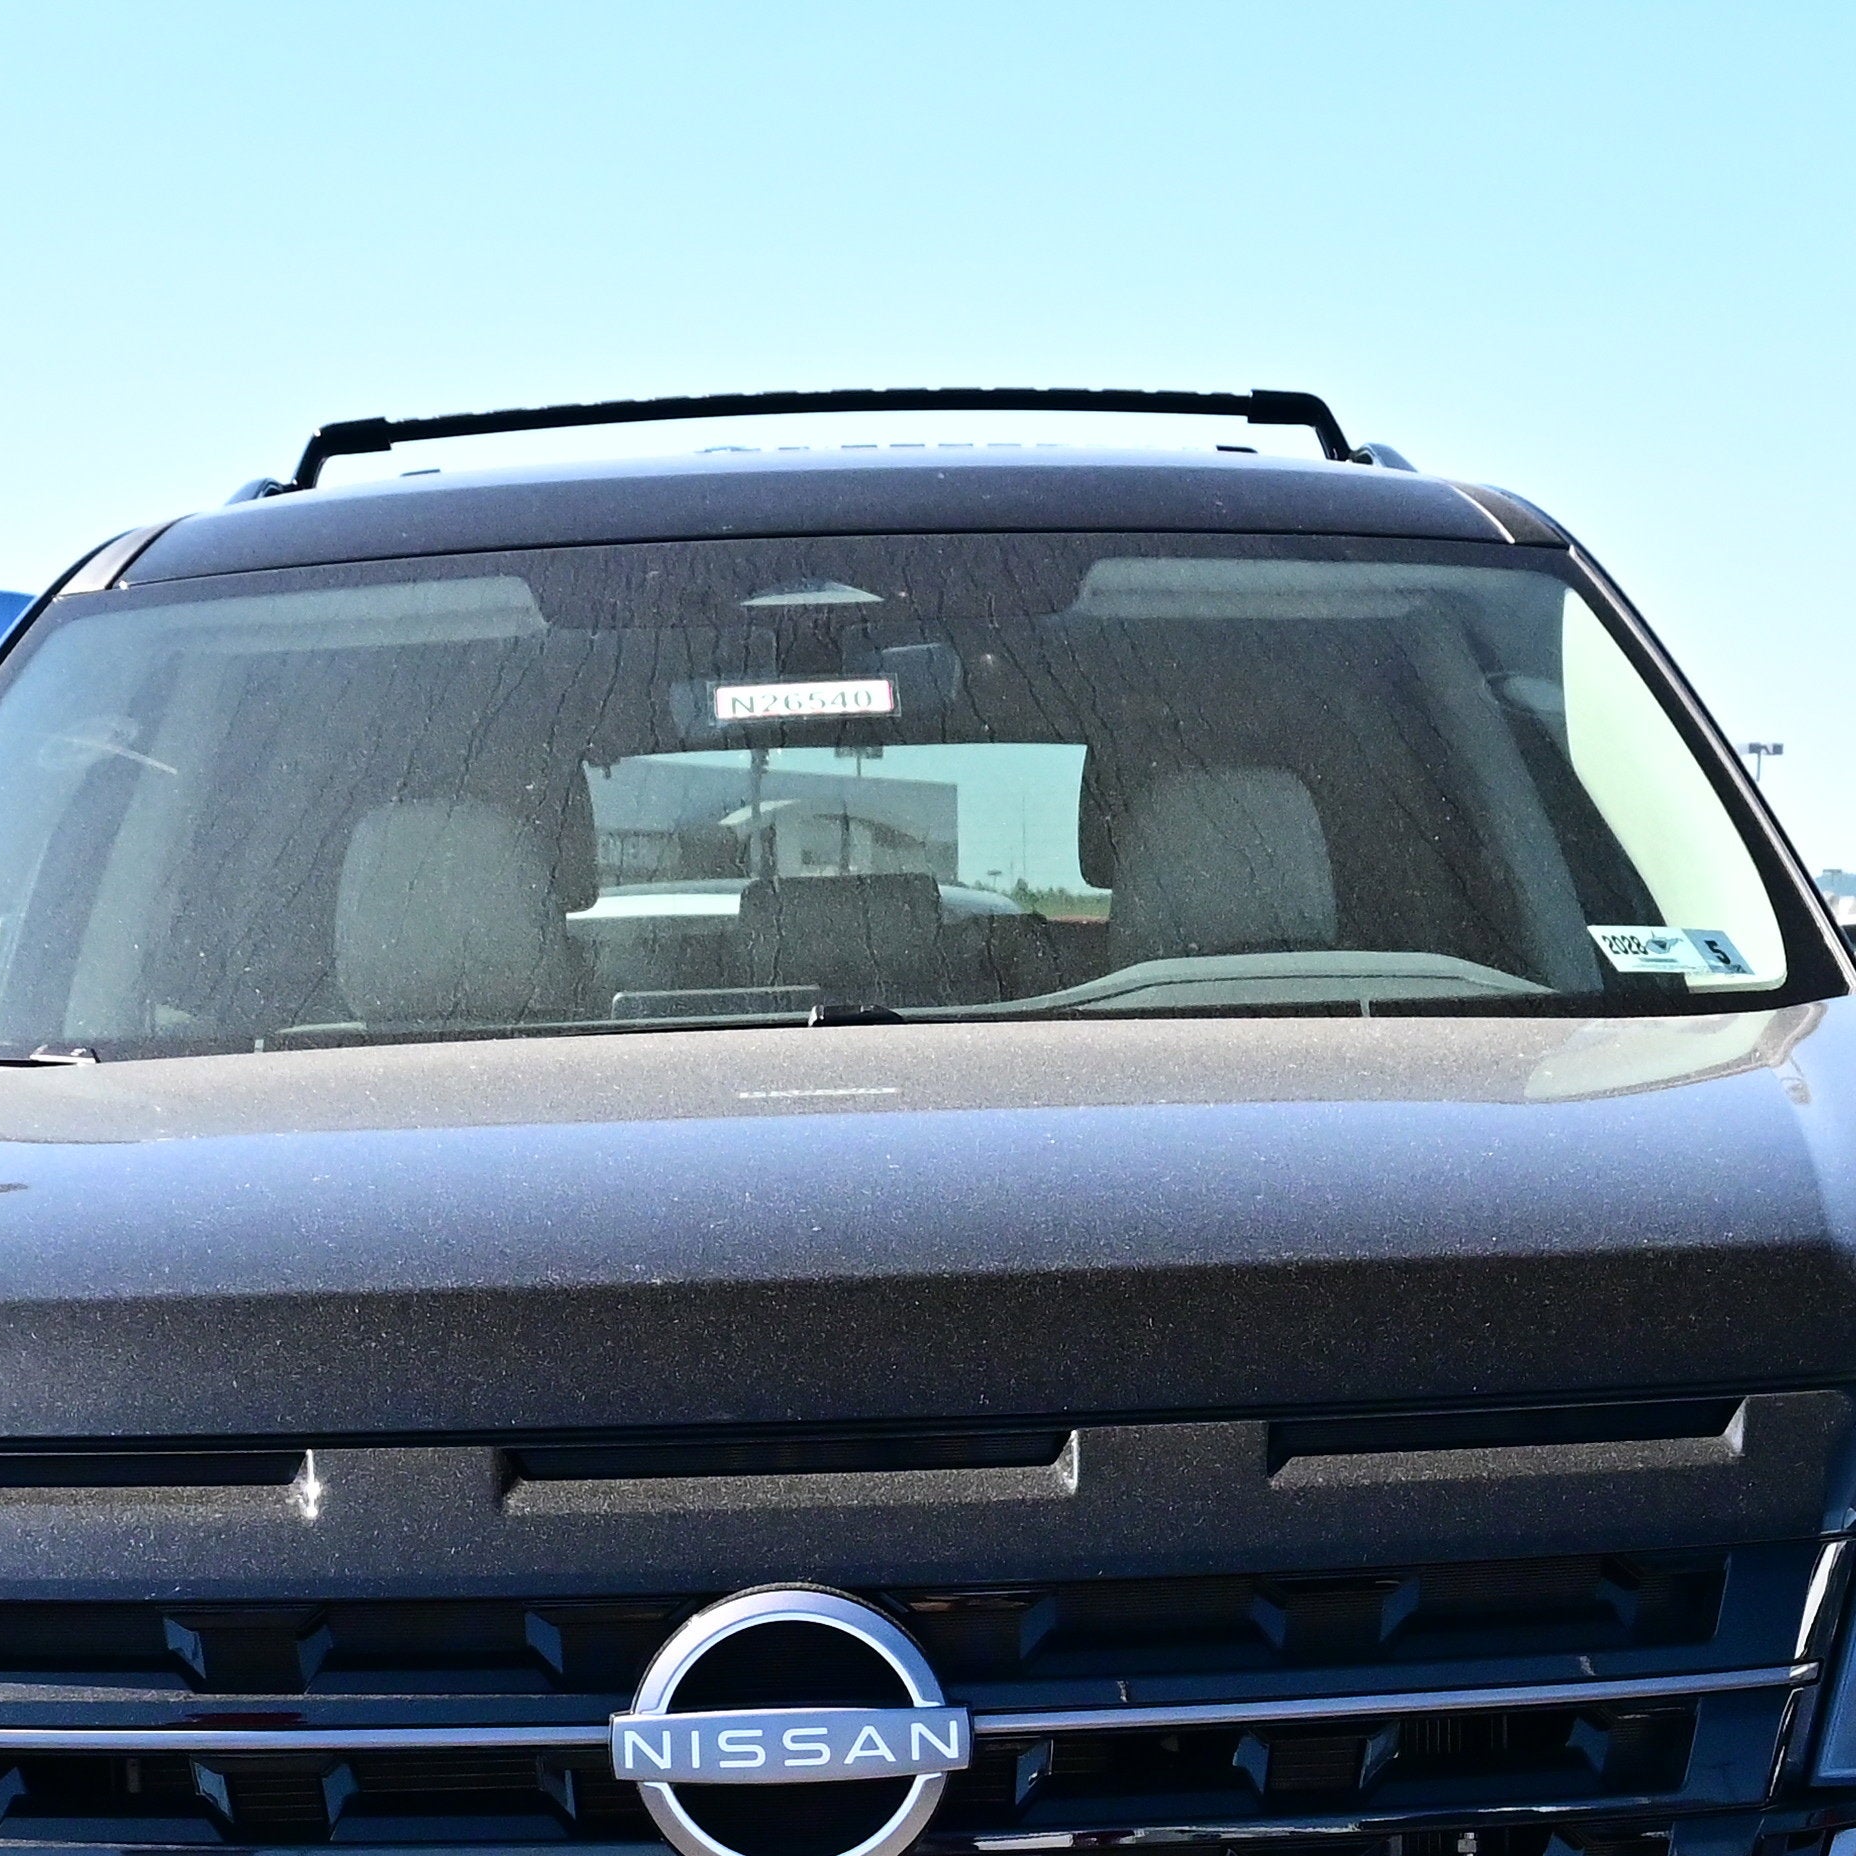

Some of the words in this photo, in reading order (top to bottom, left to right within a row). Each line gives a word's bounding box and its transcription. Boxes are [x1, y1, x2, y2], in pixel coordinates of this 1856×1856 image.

[731, 690, 872, 714] N26540
[1602, 934, 1649, 955] 2028
[1704, 940, 1731, 965] 5
[624, 1720, 959, 1769] NISSAN
